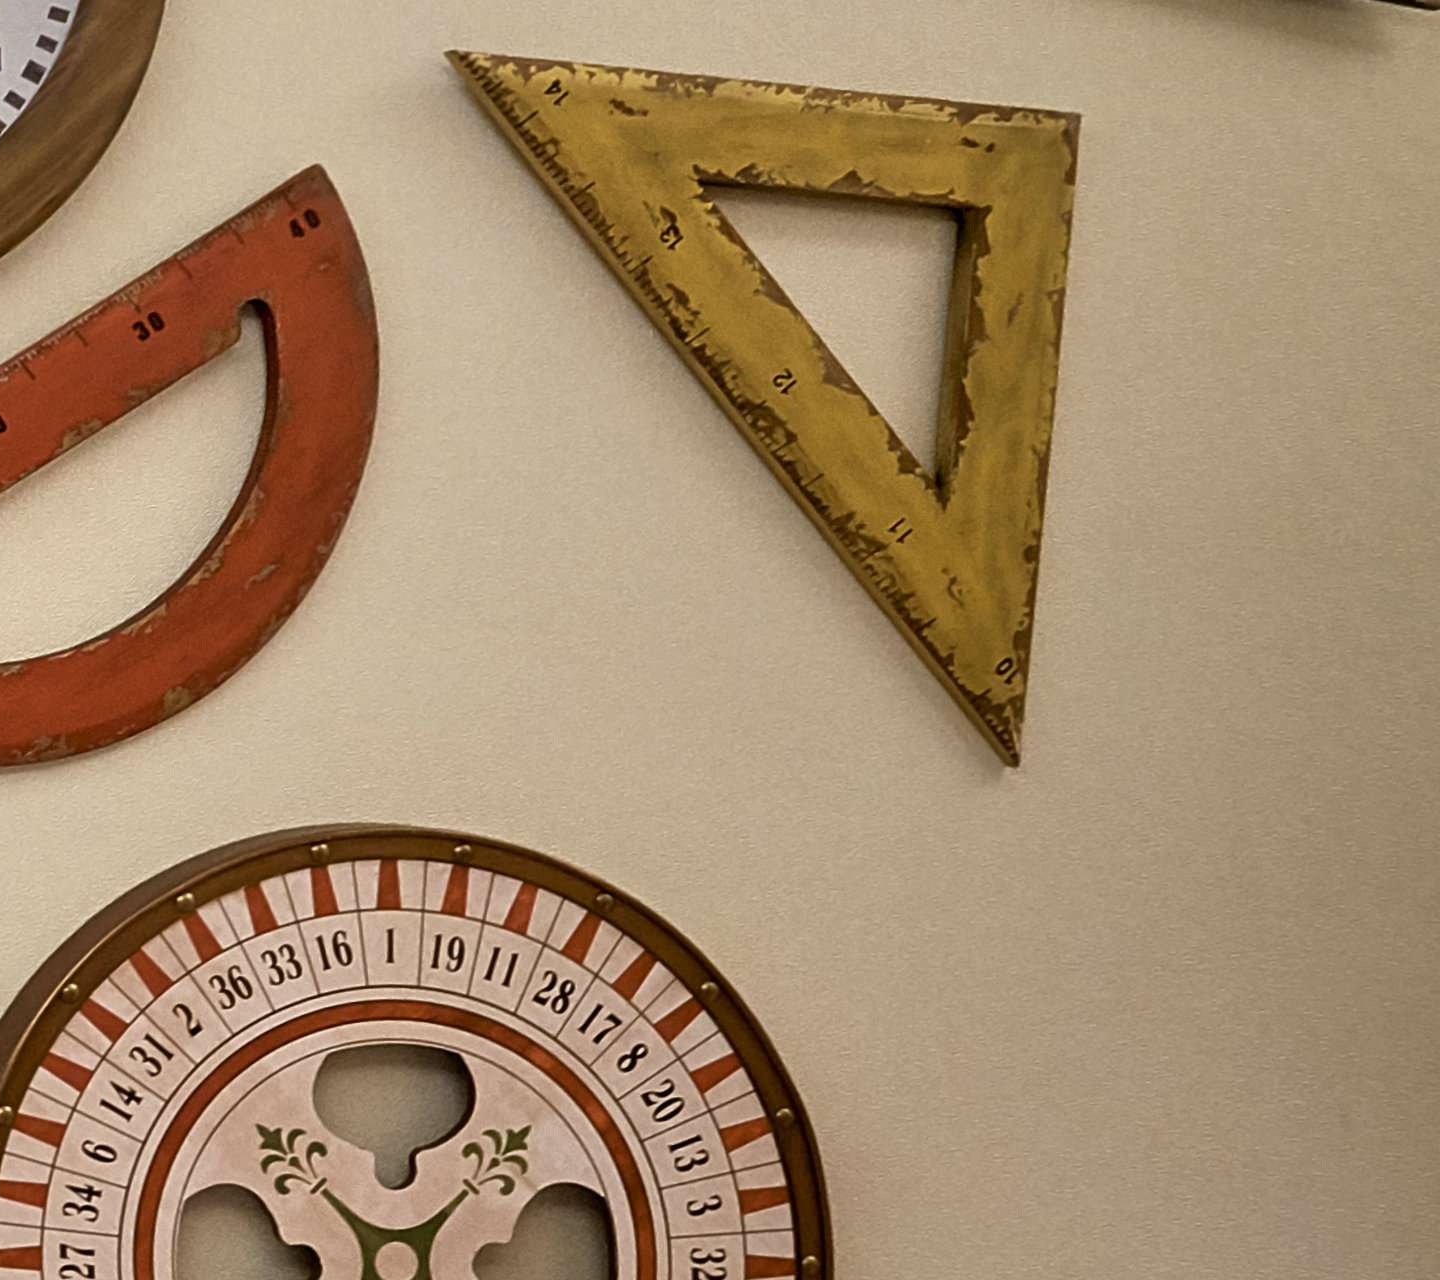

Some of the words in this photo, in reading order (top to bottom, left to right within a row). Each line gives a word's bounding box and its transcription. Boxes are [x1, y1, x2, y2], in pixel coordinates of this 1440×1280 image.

[544, 80, 569, 106] 14
[290, 209, 320, 237] 40
[660, 224, 683, 251] 13
[132, 312, 165, 341] 30
[773, 369, 797, 394] 12
[888, 518, 912, 543] 11
[995, 654, 1025, 685] 10
[316, 931, 352, 970] 16
[387, 928, 394, 963] 1
[431, 934, 465, 972] 19
[261, 944, 302, 985] 33
[484, 947, 518, 987] 11
[209, 965, 253, 1009] 36
[533, 971, 575, 1013] 28
[173, 1004, 202, 1037] 2
[578, 1004, 622, 1044] 17
[129, 1034, 174, 1077] 31
[617, 1044, 648, 1072] 8
[100, 1081, 142, 1122] 14
[641, 1079, 684, 1122] 20
[82, 1140, 117, 1162] 6
[669, 1135, 709, 1172] 13
[63, 1185, 102, 1222] 34
[687, 1195, 722, 1216] 3
[59, 1244, 95, 1279] 27
